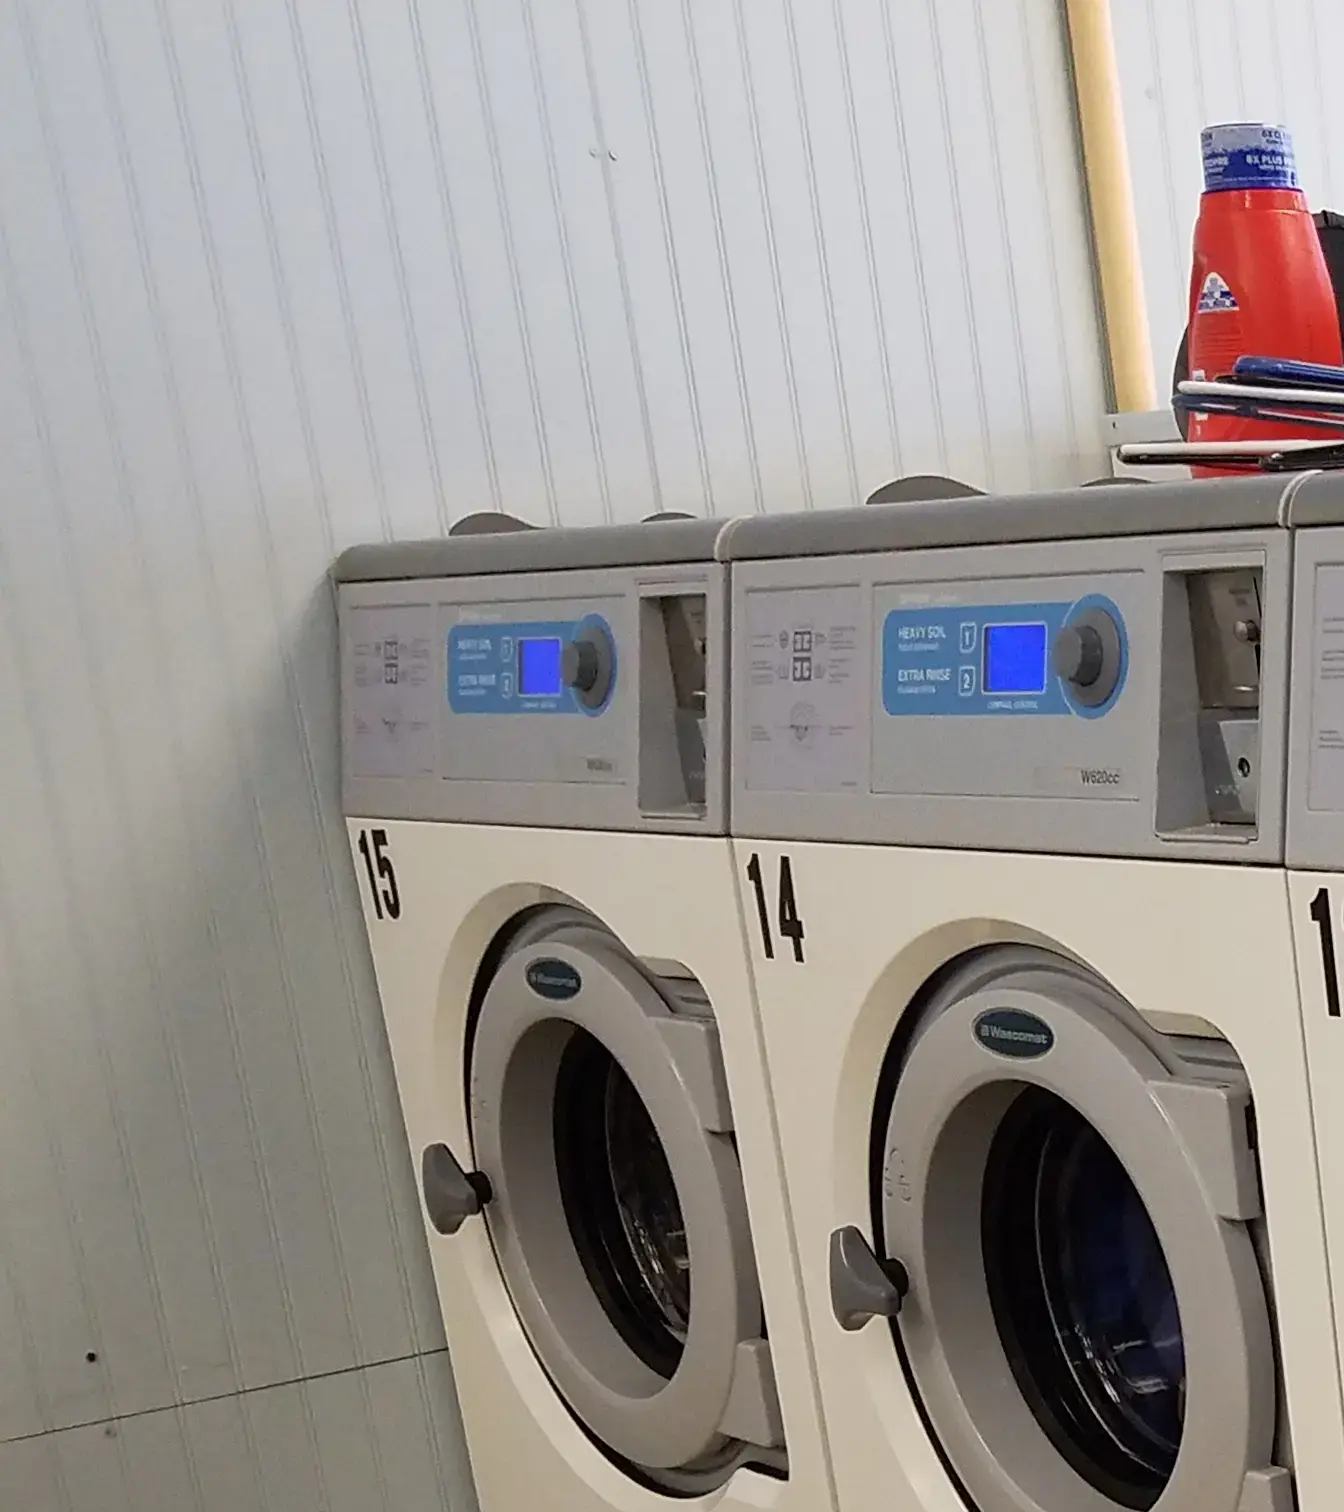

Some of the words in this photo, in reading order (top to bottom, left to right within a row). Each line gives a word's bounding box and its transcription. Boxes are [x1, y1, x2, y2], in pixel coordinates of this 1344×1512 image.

[897, 669, 925, 682] EXTRA
[358, 829, 400, 920] 15
[746, 852, 805, 964] 14
